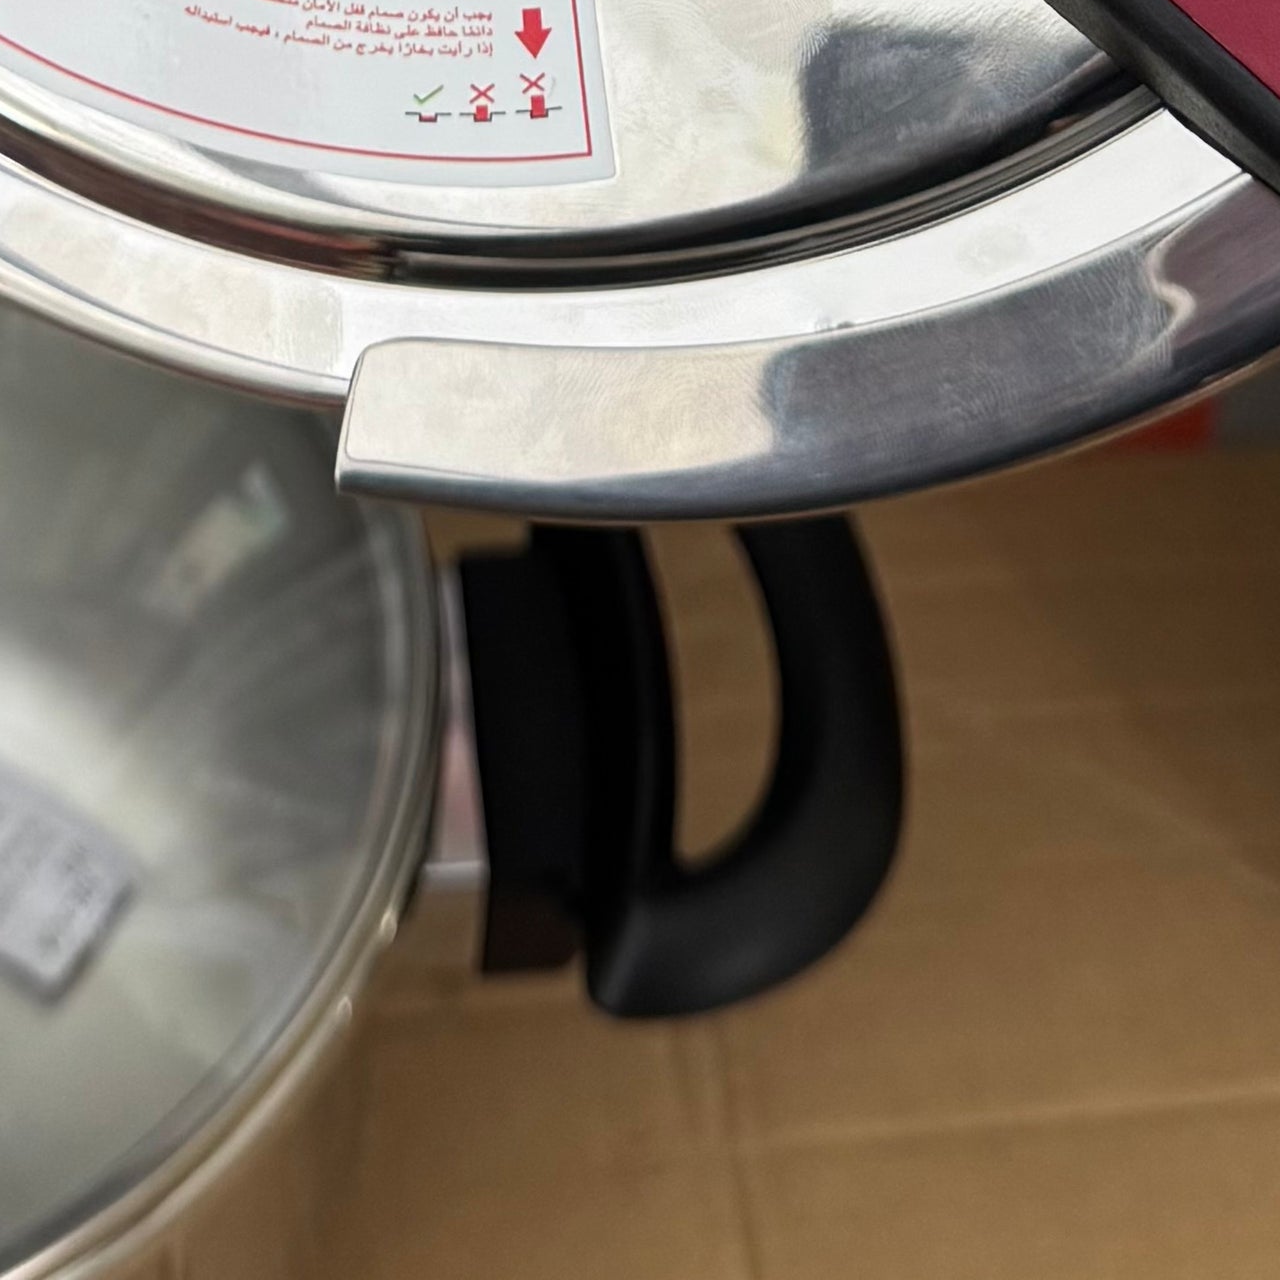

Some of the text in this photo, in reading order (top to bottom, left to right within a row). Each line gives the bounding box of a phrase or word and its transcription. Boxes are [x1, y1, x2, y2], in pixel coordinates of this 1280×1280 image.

[368, 5, 404, 20] صمام
[408, 8, 440, 22] يكون
[462, 12, 492, 22] يجب
[394, 24, 419, 39] على
[333, 40, 352, 51] من
